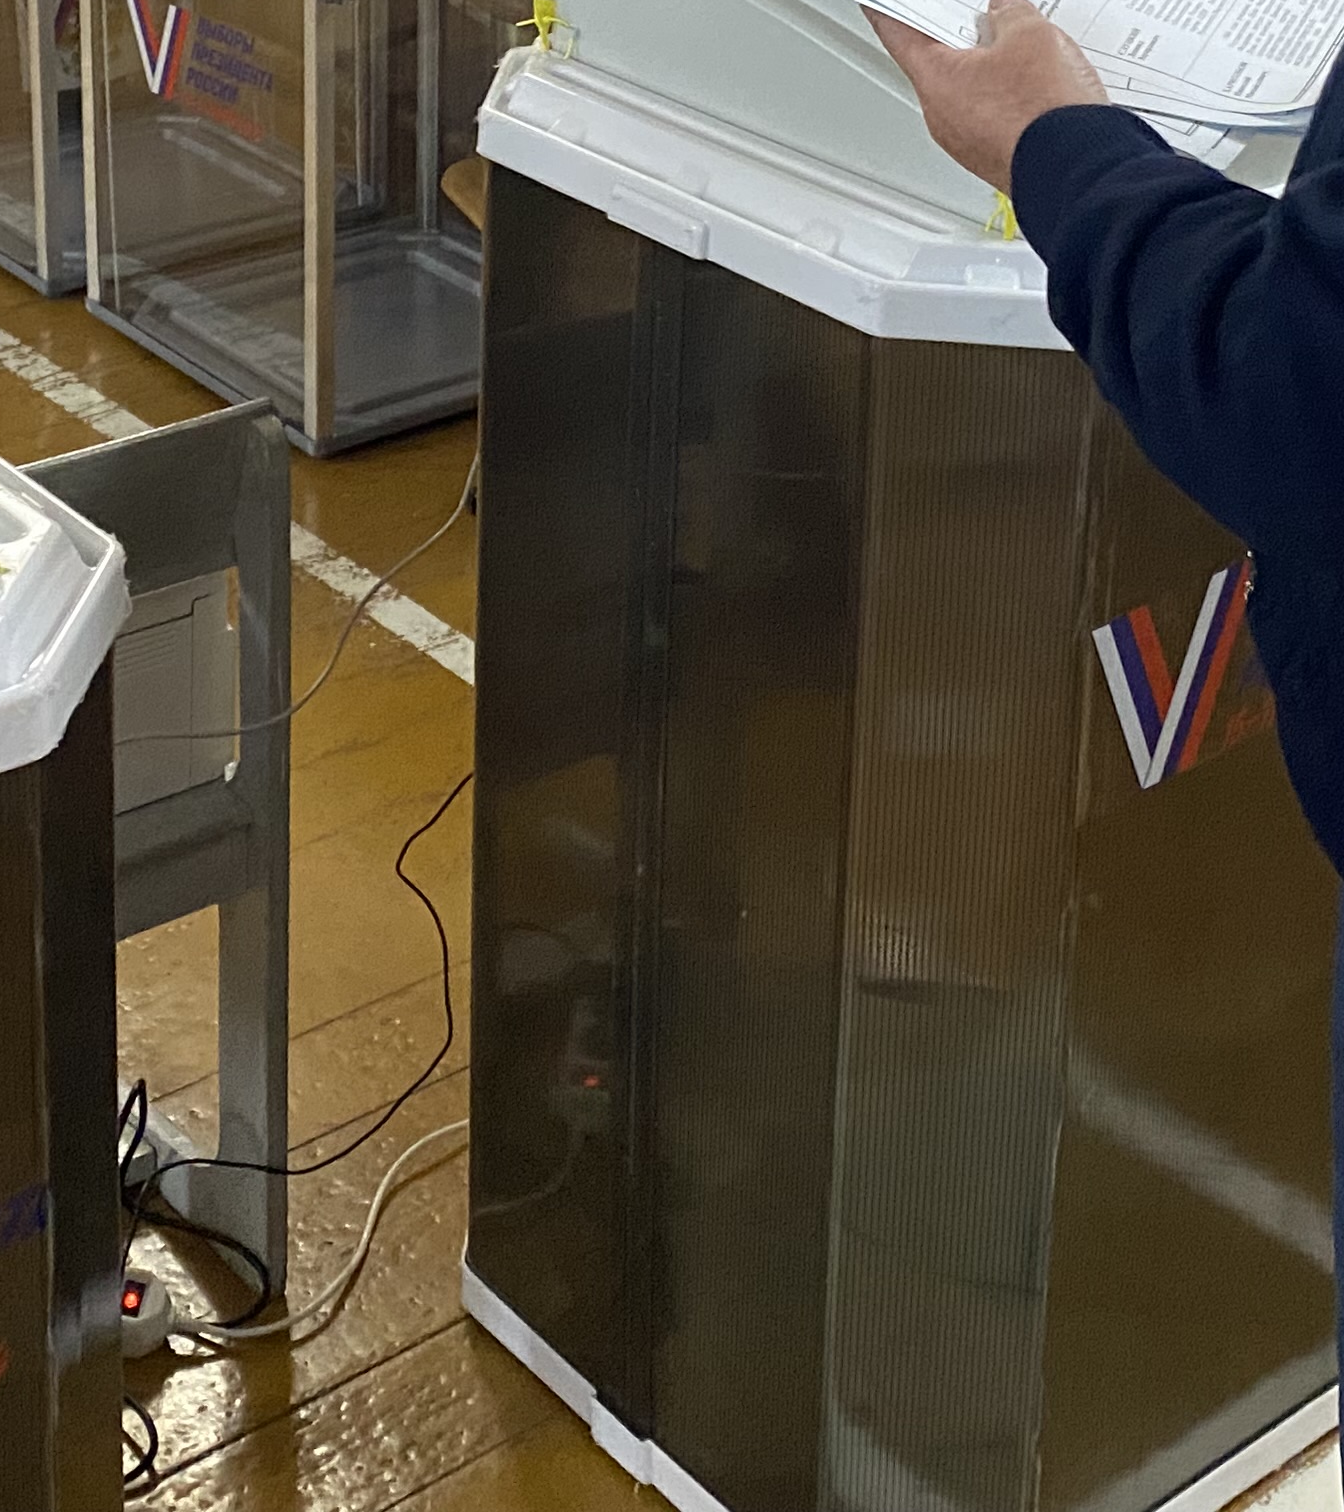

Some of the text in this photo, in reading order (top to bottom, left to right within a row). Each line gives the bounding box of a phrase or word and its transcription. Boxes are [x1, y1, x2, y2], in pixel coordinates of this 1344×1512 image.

[196, 16, 255, 54] ВЫБОРЫ
[186, 67, 239, 104] РОССИИ
[191, 42, 273, 92] ПРЕЗИДЕНТА
